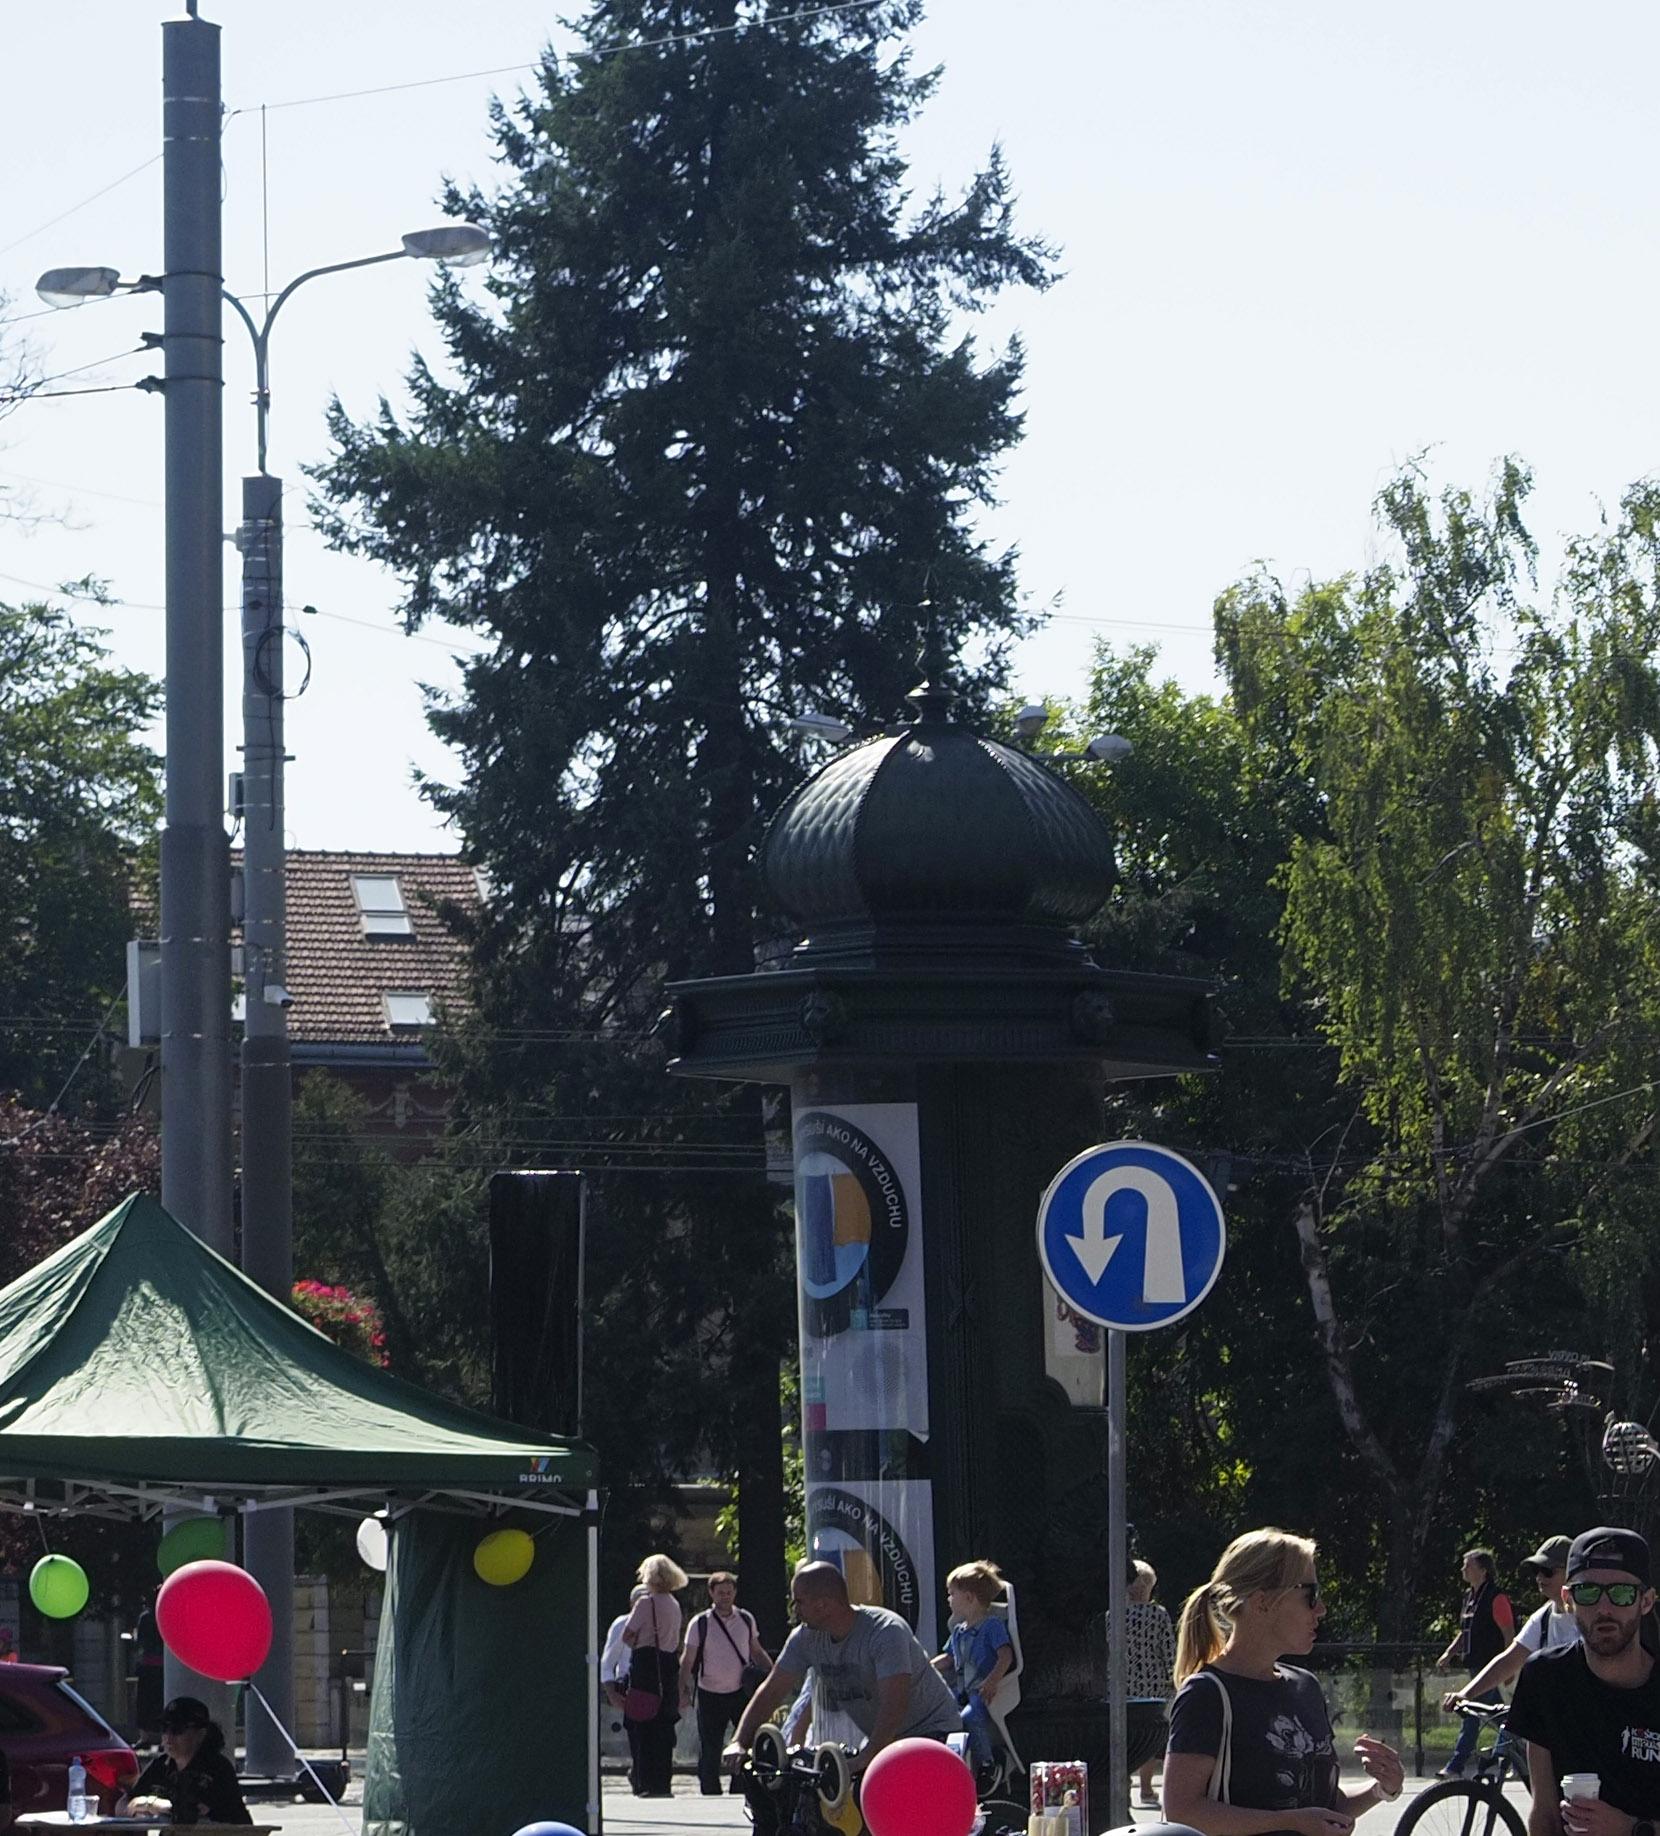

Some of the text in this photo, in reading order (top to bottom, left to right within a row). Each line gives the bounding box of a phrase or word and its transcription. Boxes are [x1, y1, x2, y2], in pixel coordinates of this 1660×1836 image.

[827, 1125, 850, 1144] AKO
[851, 1138, 868, 1159] NA
[867, 1155, 902, 1228] VZDUCHU
[837, 1502, 861, 1522] AKO
[880, 1531, 913, 1605] VZDUCHU
